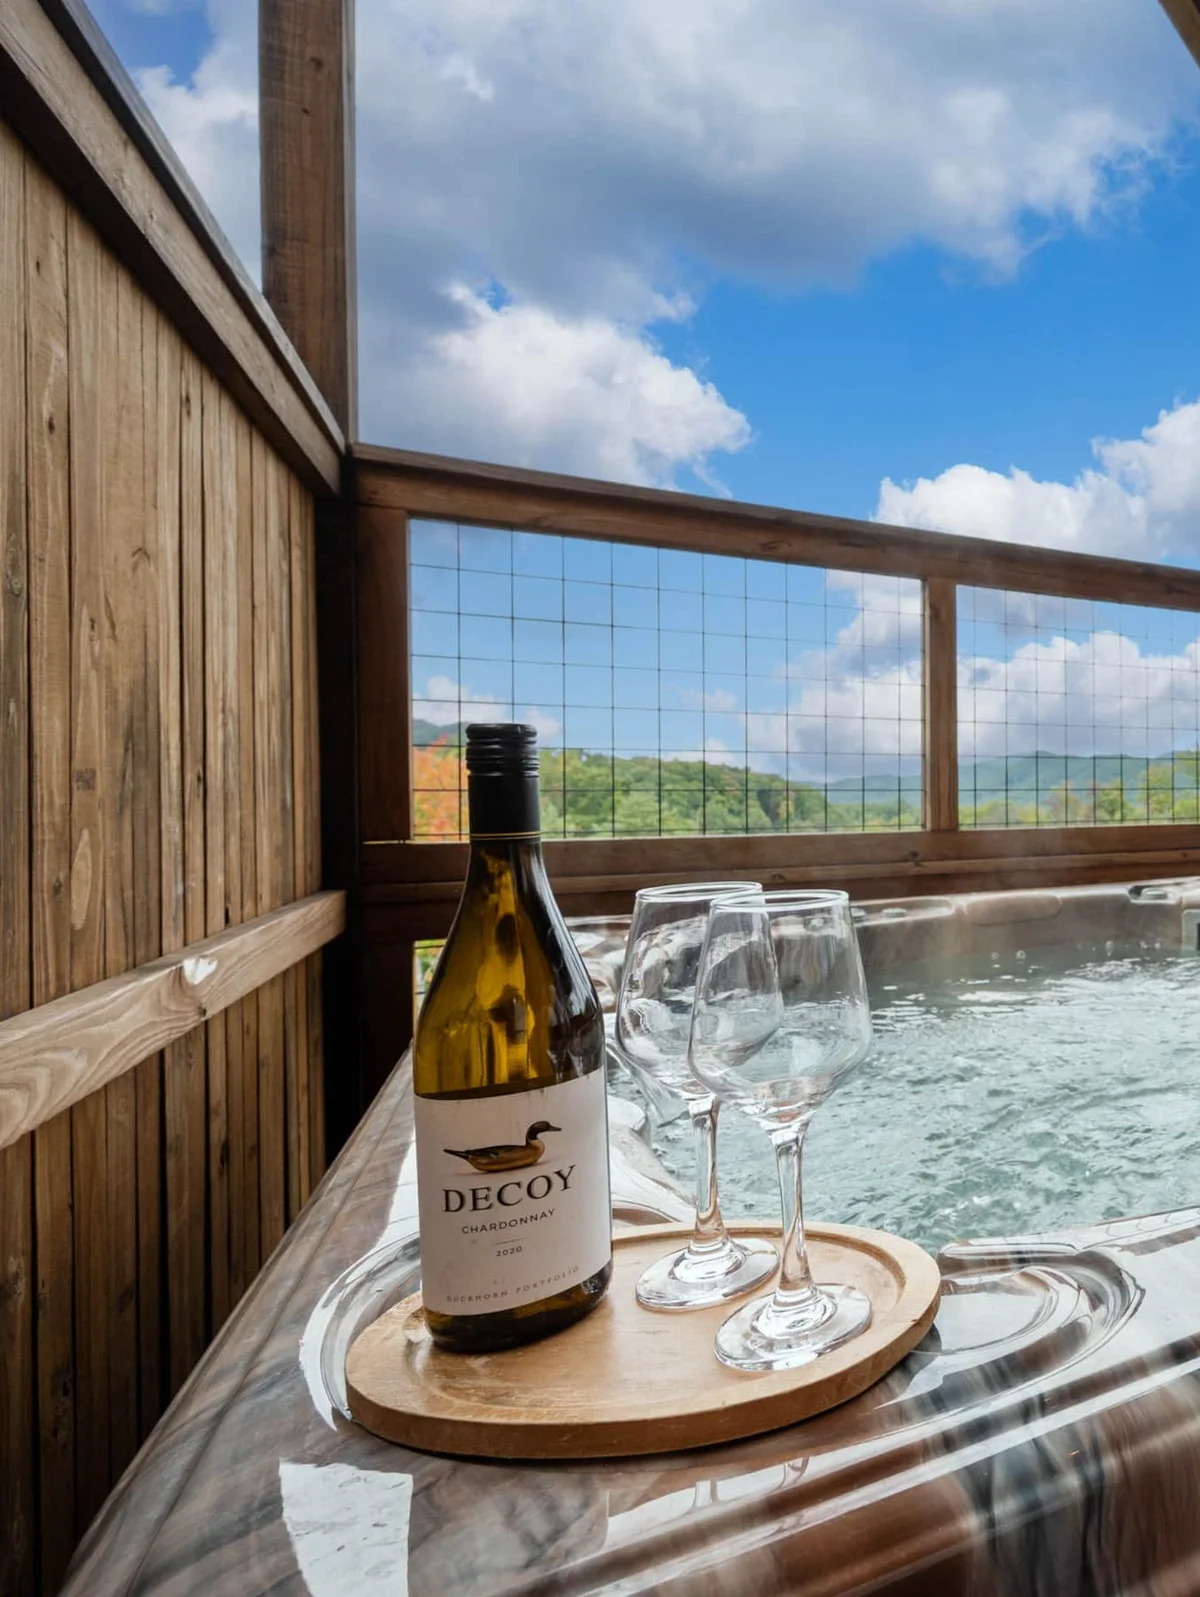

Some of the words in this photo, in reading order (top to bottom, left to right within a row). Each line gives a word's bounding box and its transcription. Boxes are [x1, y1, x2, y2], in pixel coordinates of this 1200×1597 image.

[443, 1164, 576, 1213] DECOY
[461, 1208, 556, 1234] CHARDONNAY
[496, 1246, 523, 1257] 2020
